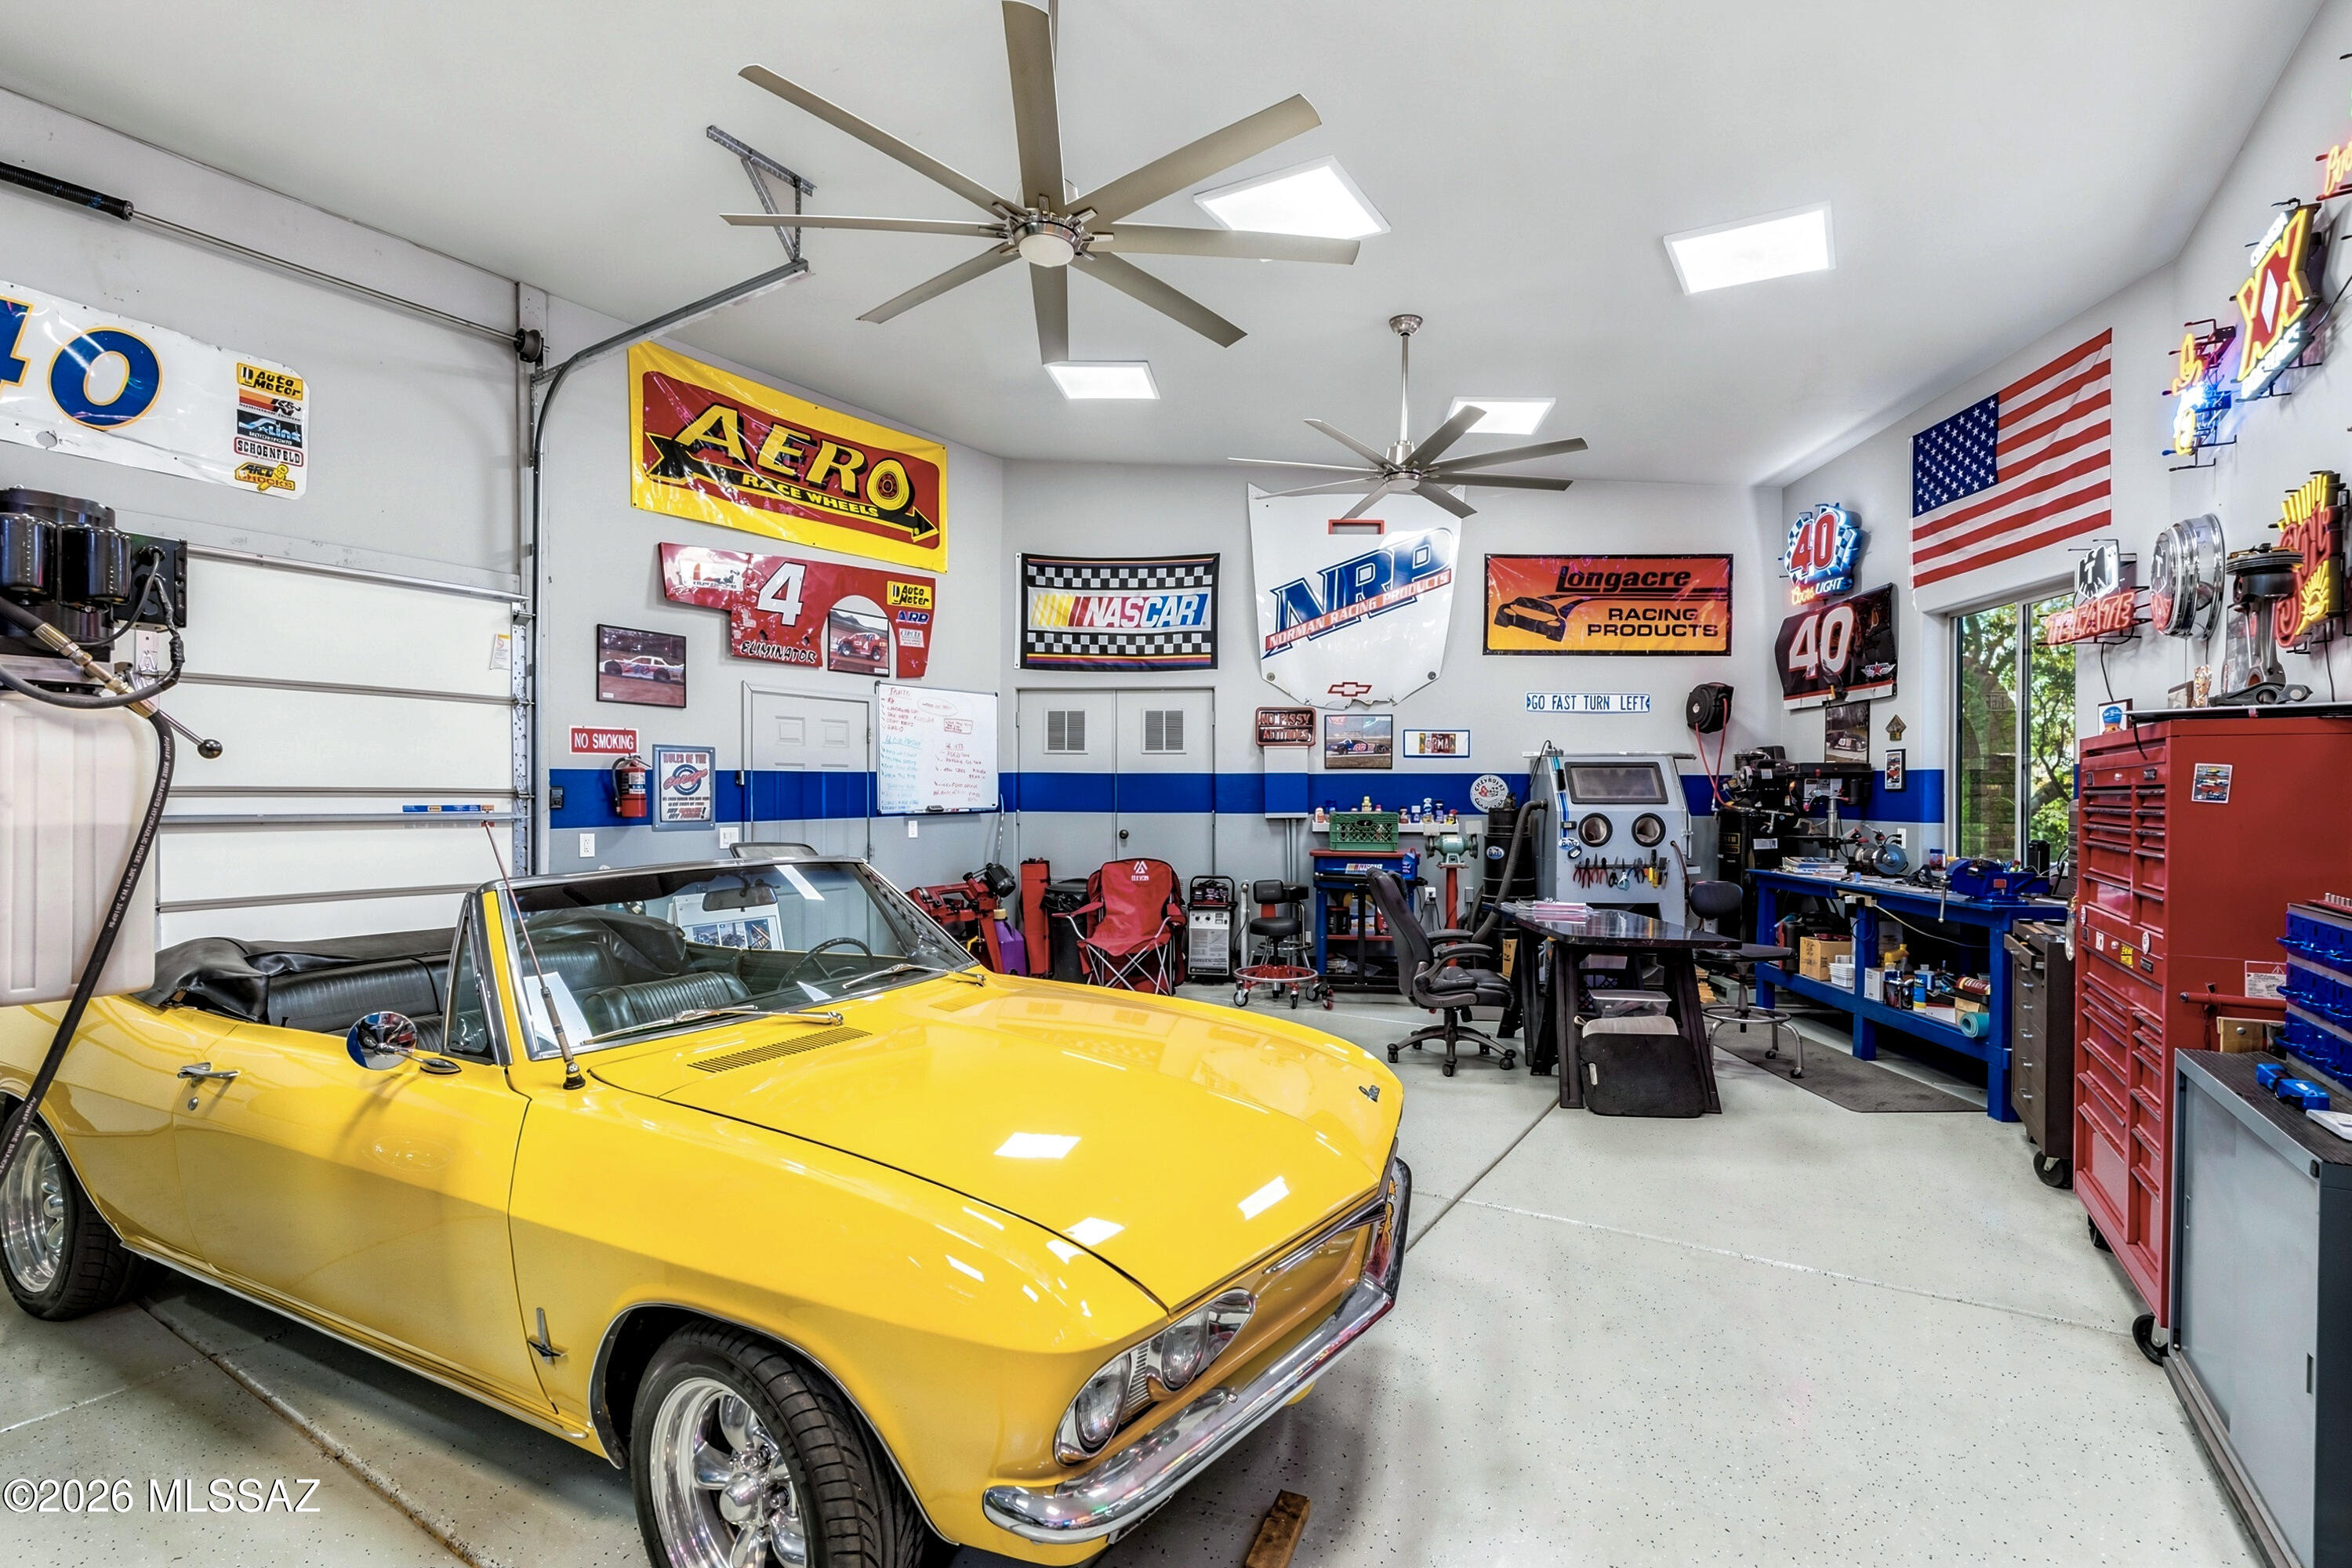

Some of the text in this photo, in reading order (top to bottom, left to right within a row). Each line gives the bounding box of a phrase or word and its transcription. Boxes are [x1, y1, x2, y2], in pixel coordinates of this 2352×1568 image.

[255, 378, 302, 397] Meter
[256, 371, 295, 387] Auto
[237, 439, 301, 464] SCHOENFELD
[675, 404, 912, 512] AERO
[742, 472, 880, 517] RACE WHEELS
[1790, 511, 1838, 575] 40
[902, 584, 925, 597] Auto
[1555, 565, 1692, 594] Longacre
[756, 561, 808, 627] 4
[900, 593, 930, 605] Meter
[1261, 527, 1454, 660] NRP
[898, 610, 930, 623] ARP
[1083, 593, 1200, 628] NASCAR
[1269, 572, 1450, 648] NORMAN RACING PRODUCTS
[1608, 608, 1699, 622] RACING
[1587, 624, 1719, 637] PRODUCTS
[1788, 604, 1856, 681] 40
[740, 640, 817, 665] ELIMINATOR
[1531, 695, 1646, 711] GO FAST TURN LEFT
[1261, 712, 1311, 726] NO PISSY
[574, 731, 634, 750] NO SMOKING
[143, 807, 158, 844] HYDRAULIC
